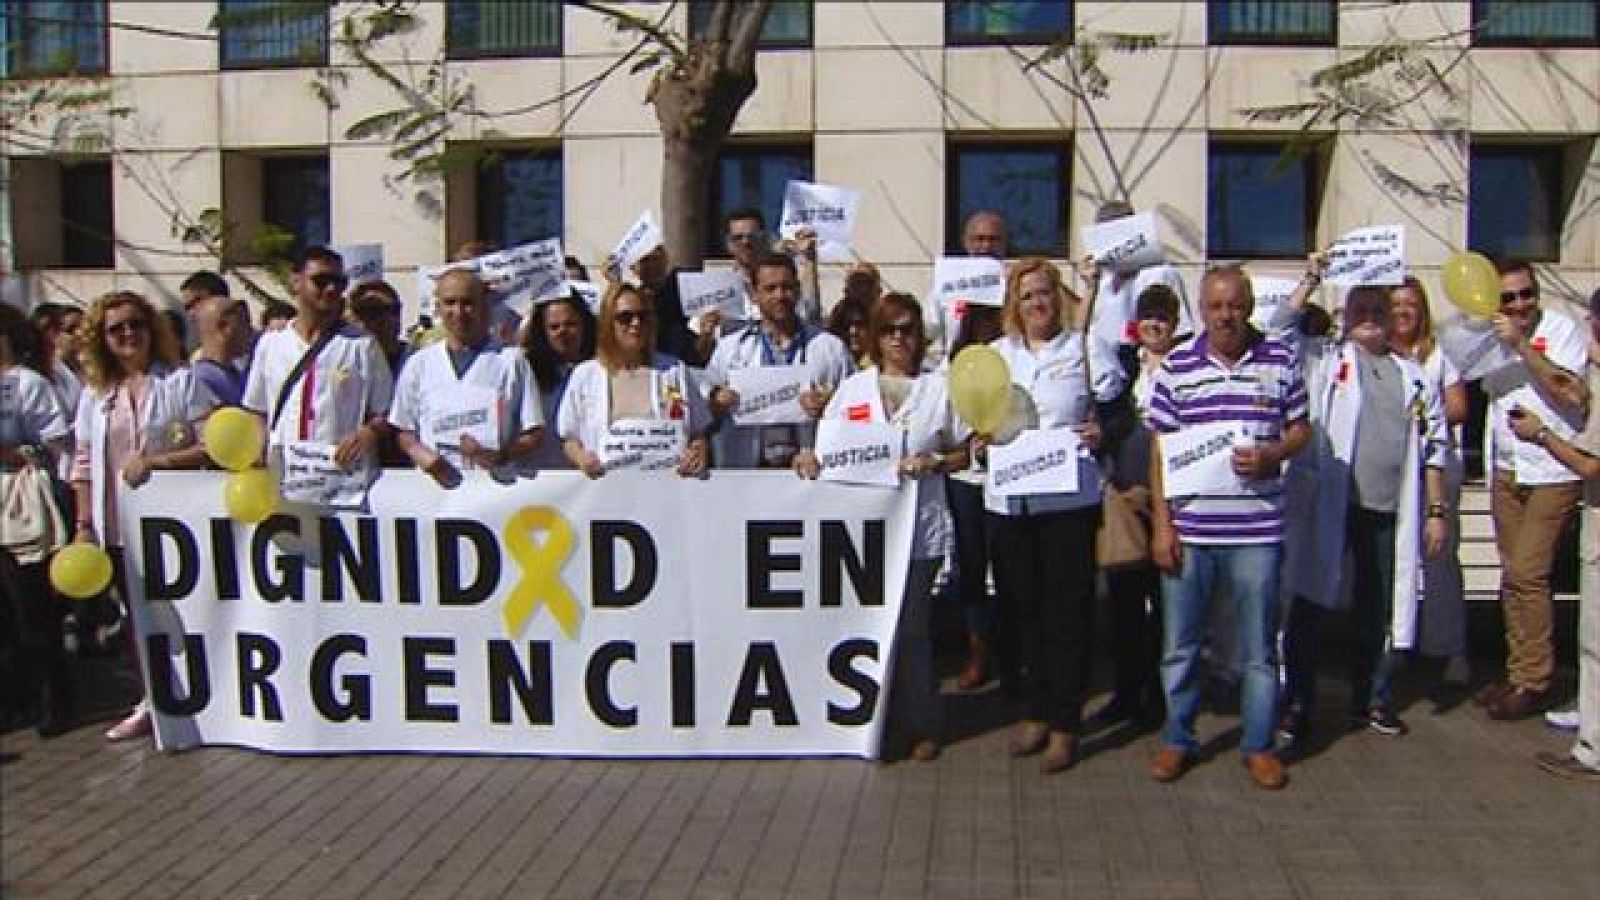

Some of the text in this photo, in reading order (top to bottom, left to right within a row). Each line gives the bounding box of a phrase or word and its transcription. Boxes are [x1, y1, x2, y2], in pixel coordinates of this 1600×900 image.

[818, 444, 891, 470] JUSTICIA
[746, 519, 886, 608] EN
[145, 624, 882, 728] URGENCIAS
